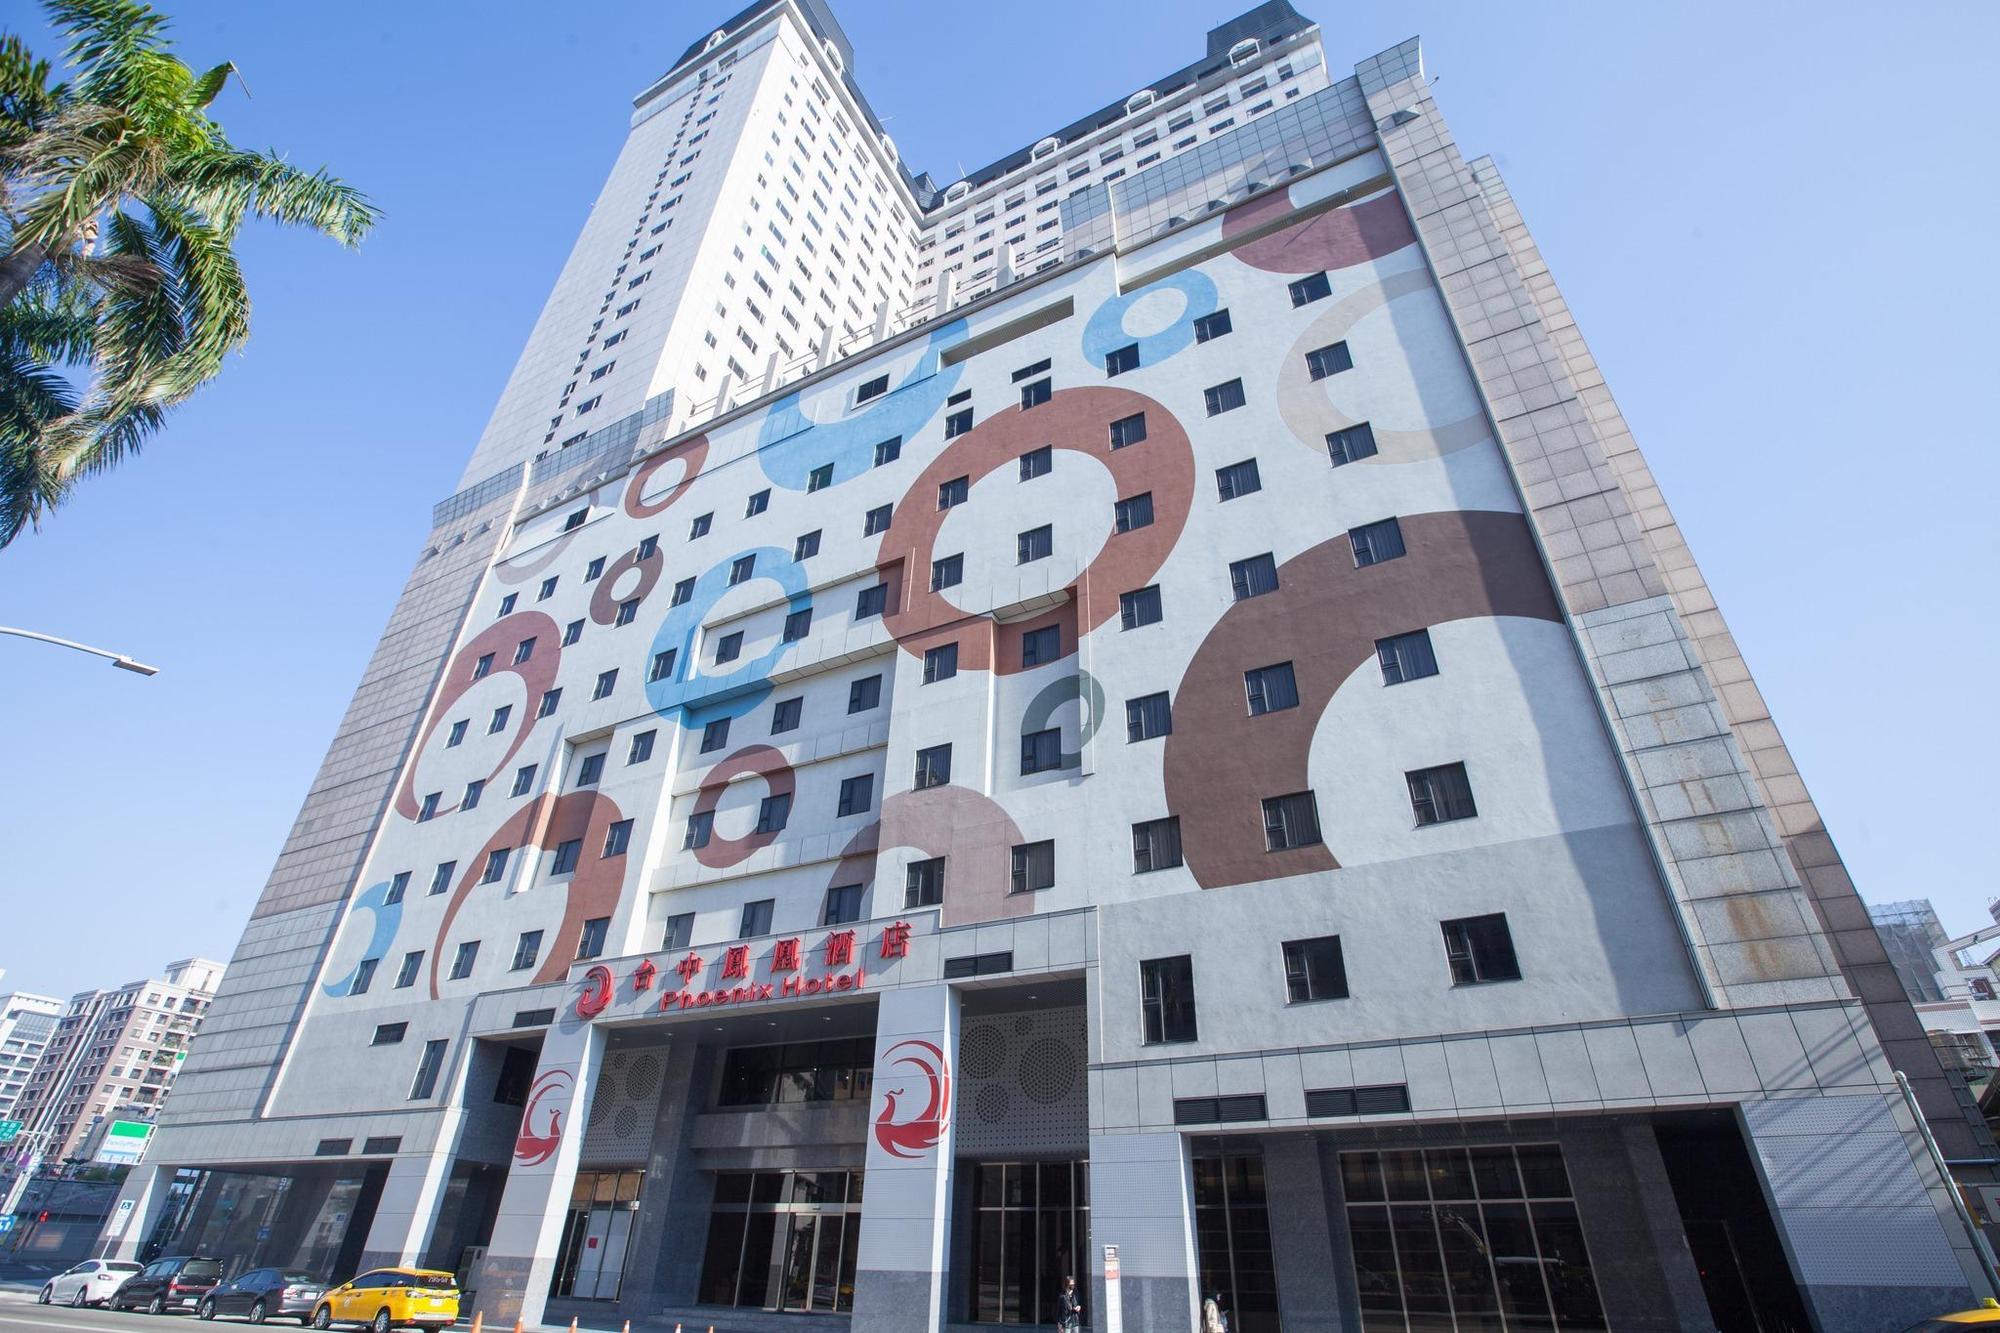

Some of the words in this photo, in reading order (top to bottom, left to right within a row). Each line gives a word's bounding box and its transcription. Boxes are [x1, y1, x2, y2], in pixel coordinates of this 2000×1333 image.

[632, 920, 912, 992] 台中鳳凰酒店
[660, 982, 774, 1011] Phoenix
[781, 967, 865, 998] Hotel
